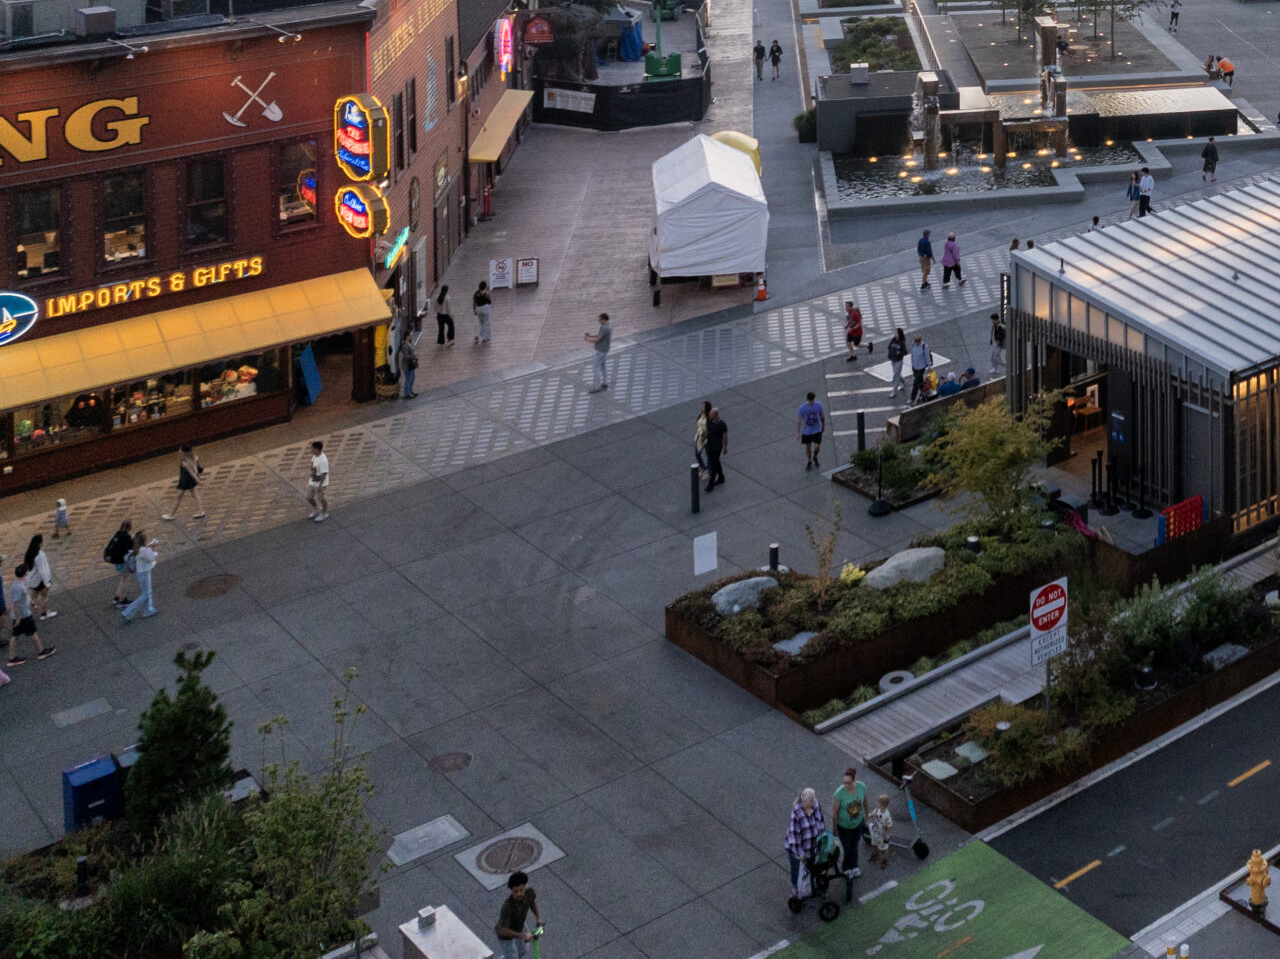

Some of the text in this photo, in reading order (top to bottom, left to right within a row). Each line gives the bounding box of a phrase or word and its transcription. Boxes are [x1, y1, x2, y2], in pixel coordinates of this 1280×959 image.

[47, 256, 263, 318] IMPORTS & GIFTS
[1036, 589, 1061, 607] DO NOT
[1038, 610, 1059, 625] ENTER
[1034, 636, 1064, 654] AUTHORIZED
[1038, 631, 1059, 645] EXCEPT
[1037, 646, 1062, 661] VEHICLES
